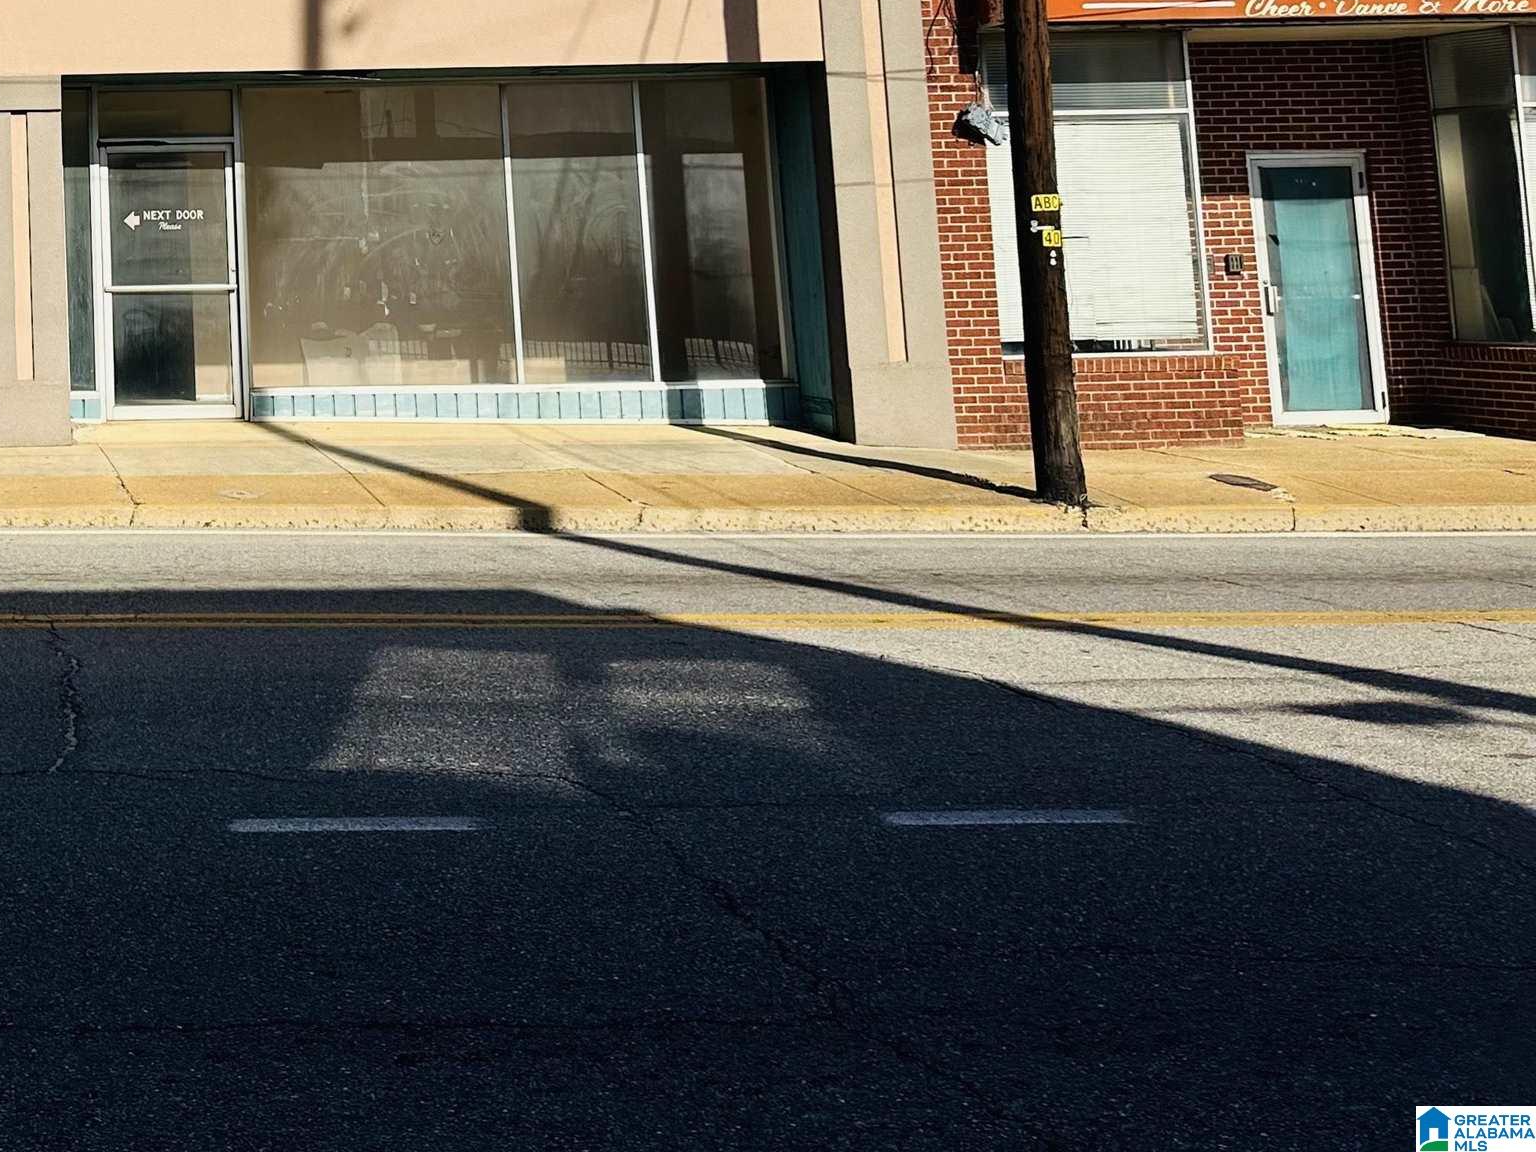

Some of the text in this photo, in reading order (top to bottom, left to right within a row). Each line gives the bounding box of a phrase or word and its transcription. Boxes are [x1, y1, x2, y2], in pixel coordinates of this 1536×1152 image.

[143, 209, 204, 220] NEXT DOOR
[158, 221, 182, 232] Please
